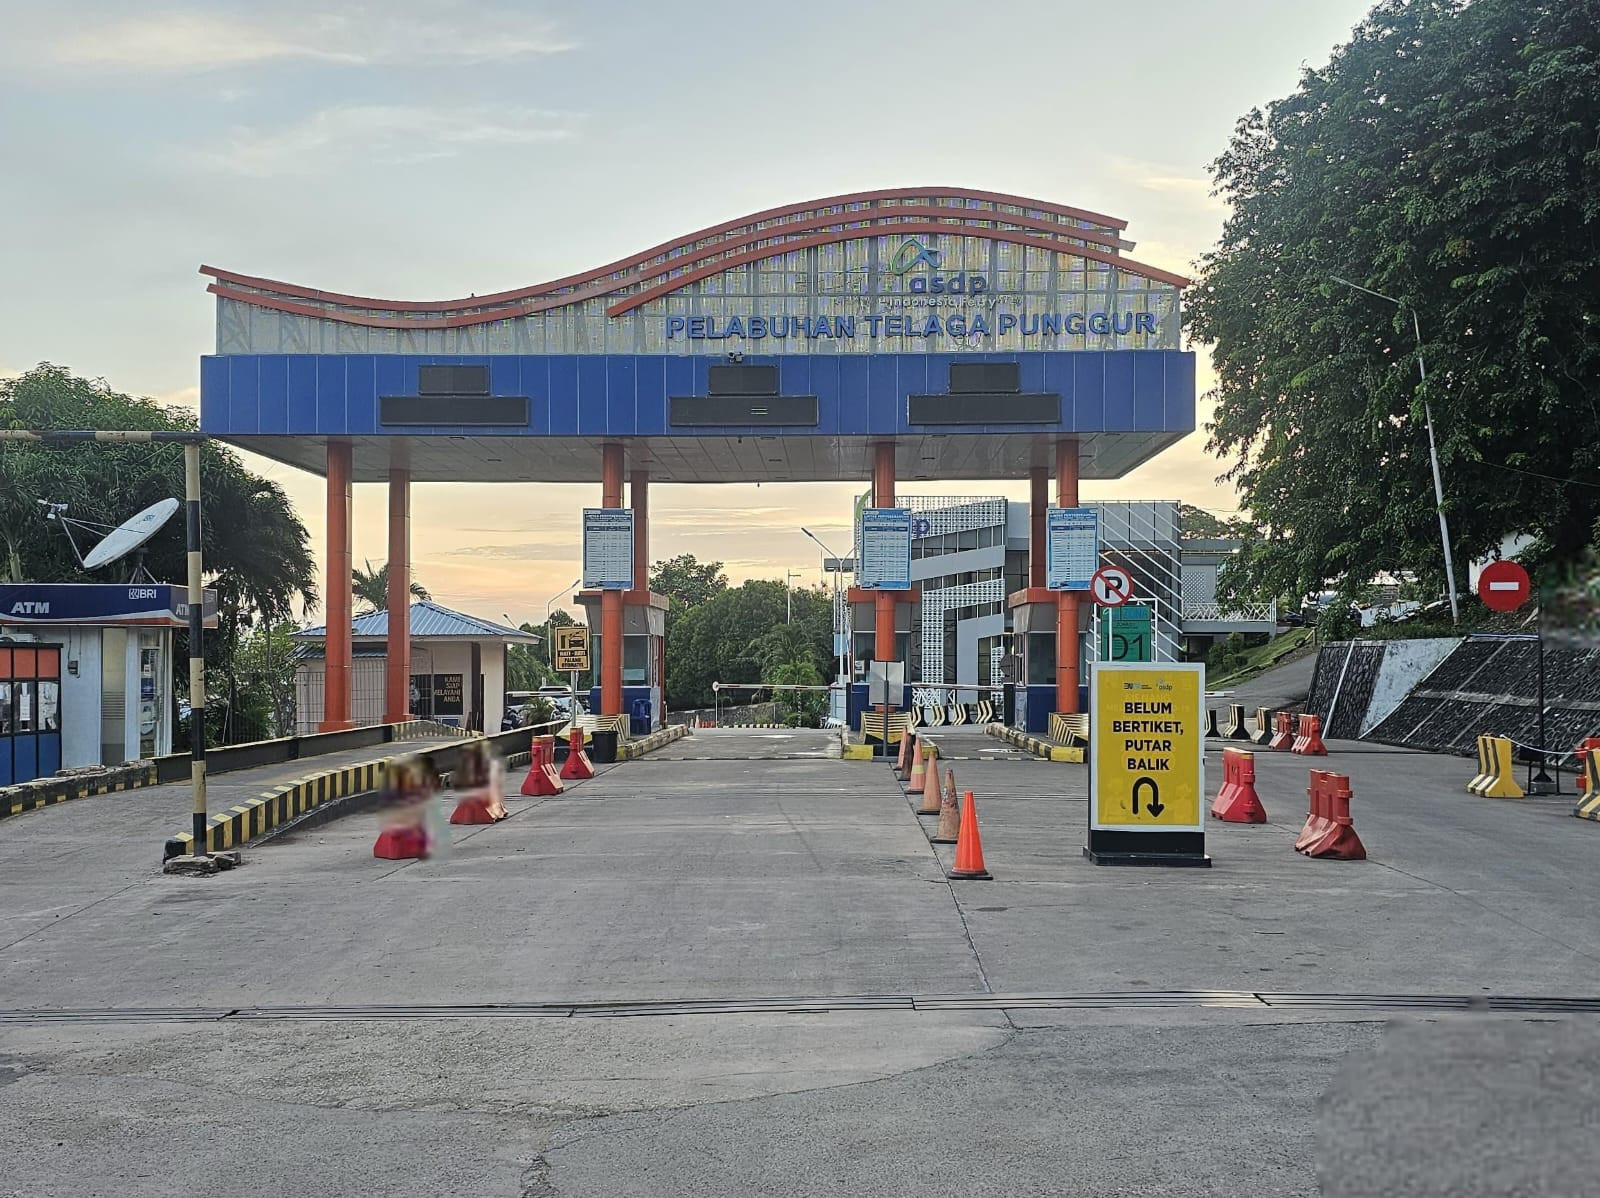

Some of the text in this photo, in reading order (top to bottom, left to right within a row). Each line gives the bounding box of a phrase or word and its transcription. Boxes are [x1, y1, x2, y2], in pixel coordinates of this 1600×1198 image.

[909, 272, 989, 297] asdp
[889, 296, 997, 311] Indonesia Ferry
[667, 312, 1157, 339] PELABUHAN TELAGA PUNGGUR
[139, 589, 157, 599] BRI
[11, 601, 50, 614] ATM
[1124, 702, 1172, 714] BELUM
[1113, 721, 1184, 735] BERTIKET,
[1125, 740, 1171, 752] PUTAR
[1127, 758, 1170, 770] BALIK
